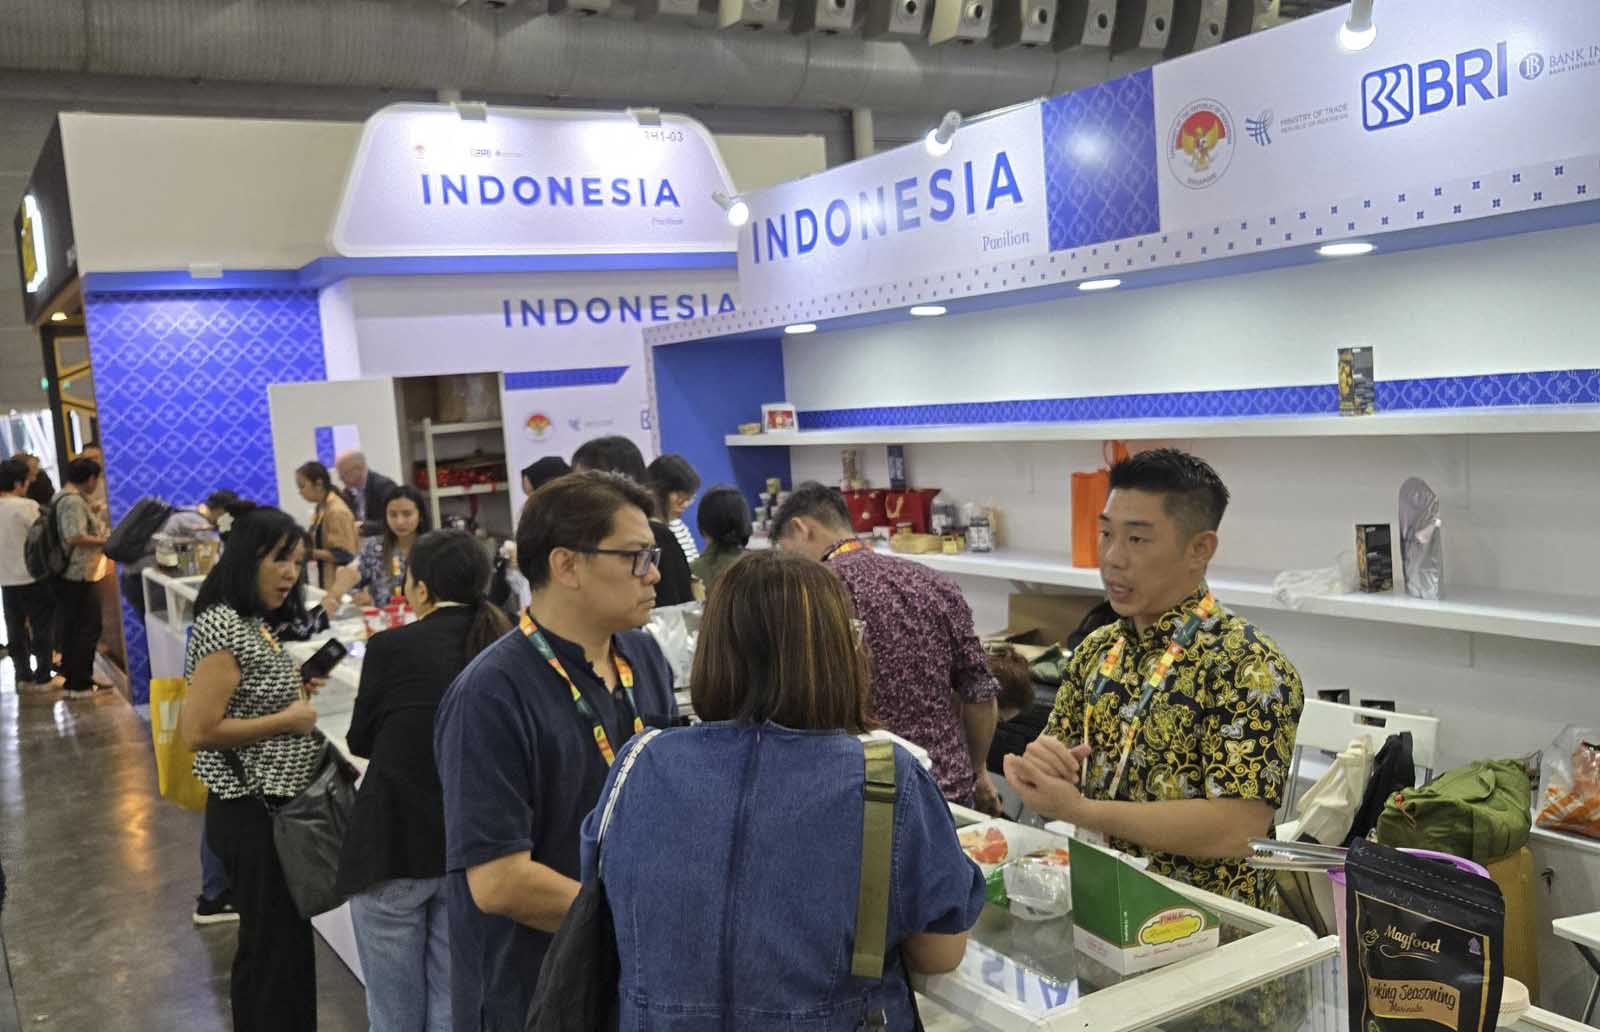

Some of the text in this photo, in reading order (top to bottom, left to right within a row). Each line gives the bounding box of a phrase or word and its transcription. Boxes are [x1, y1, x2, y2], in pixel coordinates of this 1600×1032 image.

[1549, 47, 1585, 68] BANK
[1417, 40, 1508, 115] BRI
[421, 173, 680, 207] INDONESIA
[752, 151, 1023, 265] INDONESIA
[982, 230, 1031, 252] Pavilion
[502, 292, 736, 328] INDONESIA
[1384, 924, 1441, 953] Magfood
[1400, 984, 1456, 1010] Seasoning
